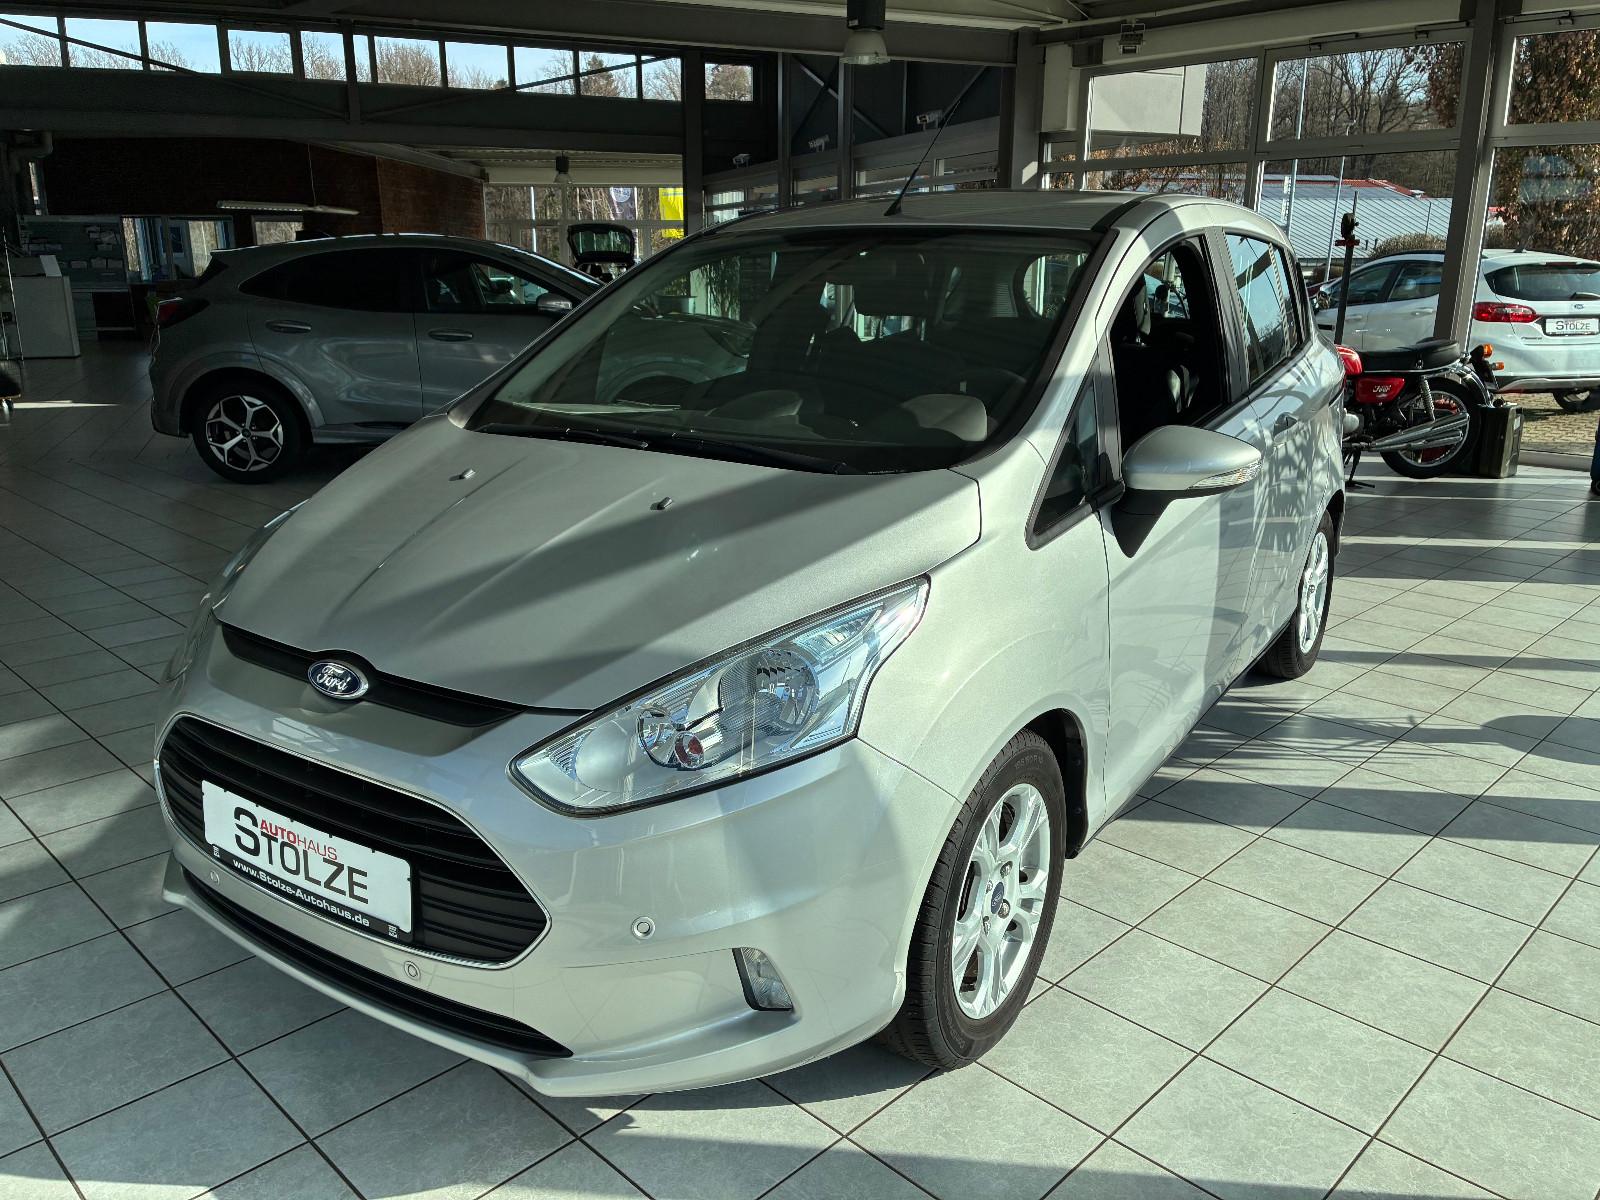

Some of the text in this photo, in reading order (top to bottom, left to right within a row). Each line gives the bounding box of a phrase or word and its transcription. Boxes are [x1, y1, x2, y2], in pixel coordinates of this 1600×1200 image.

[1556, 320, 1591, 331] STOLZE
[316, 665, 352, 693] Ford
[234, 806, 369, 905] STOLZE
[260, 819, 338, 861] AUTOHAUS
[232, 859, 370, 927] www.Stolze-Autohaus.de
